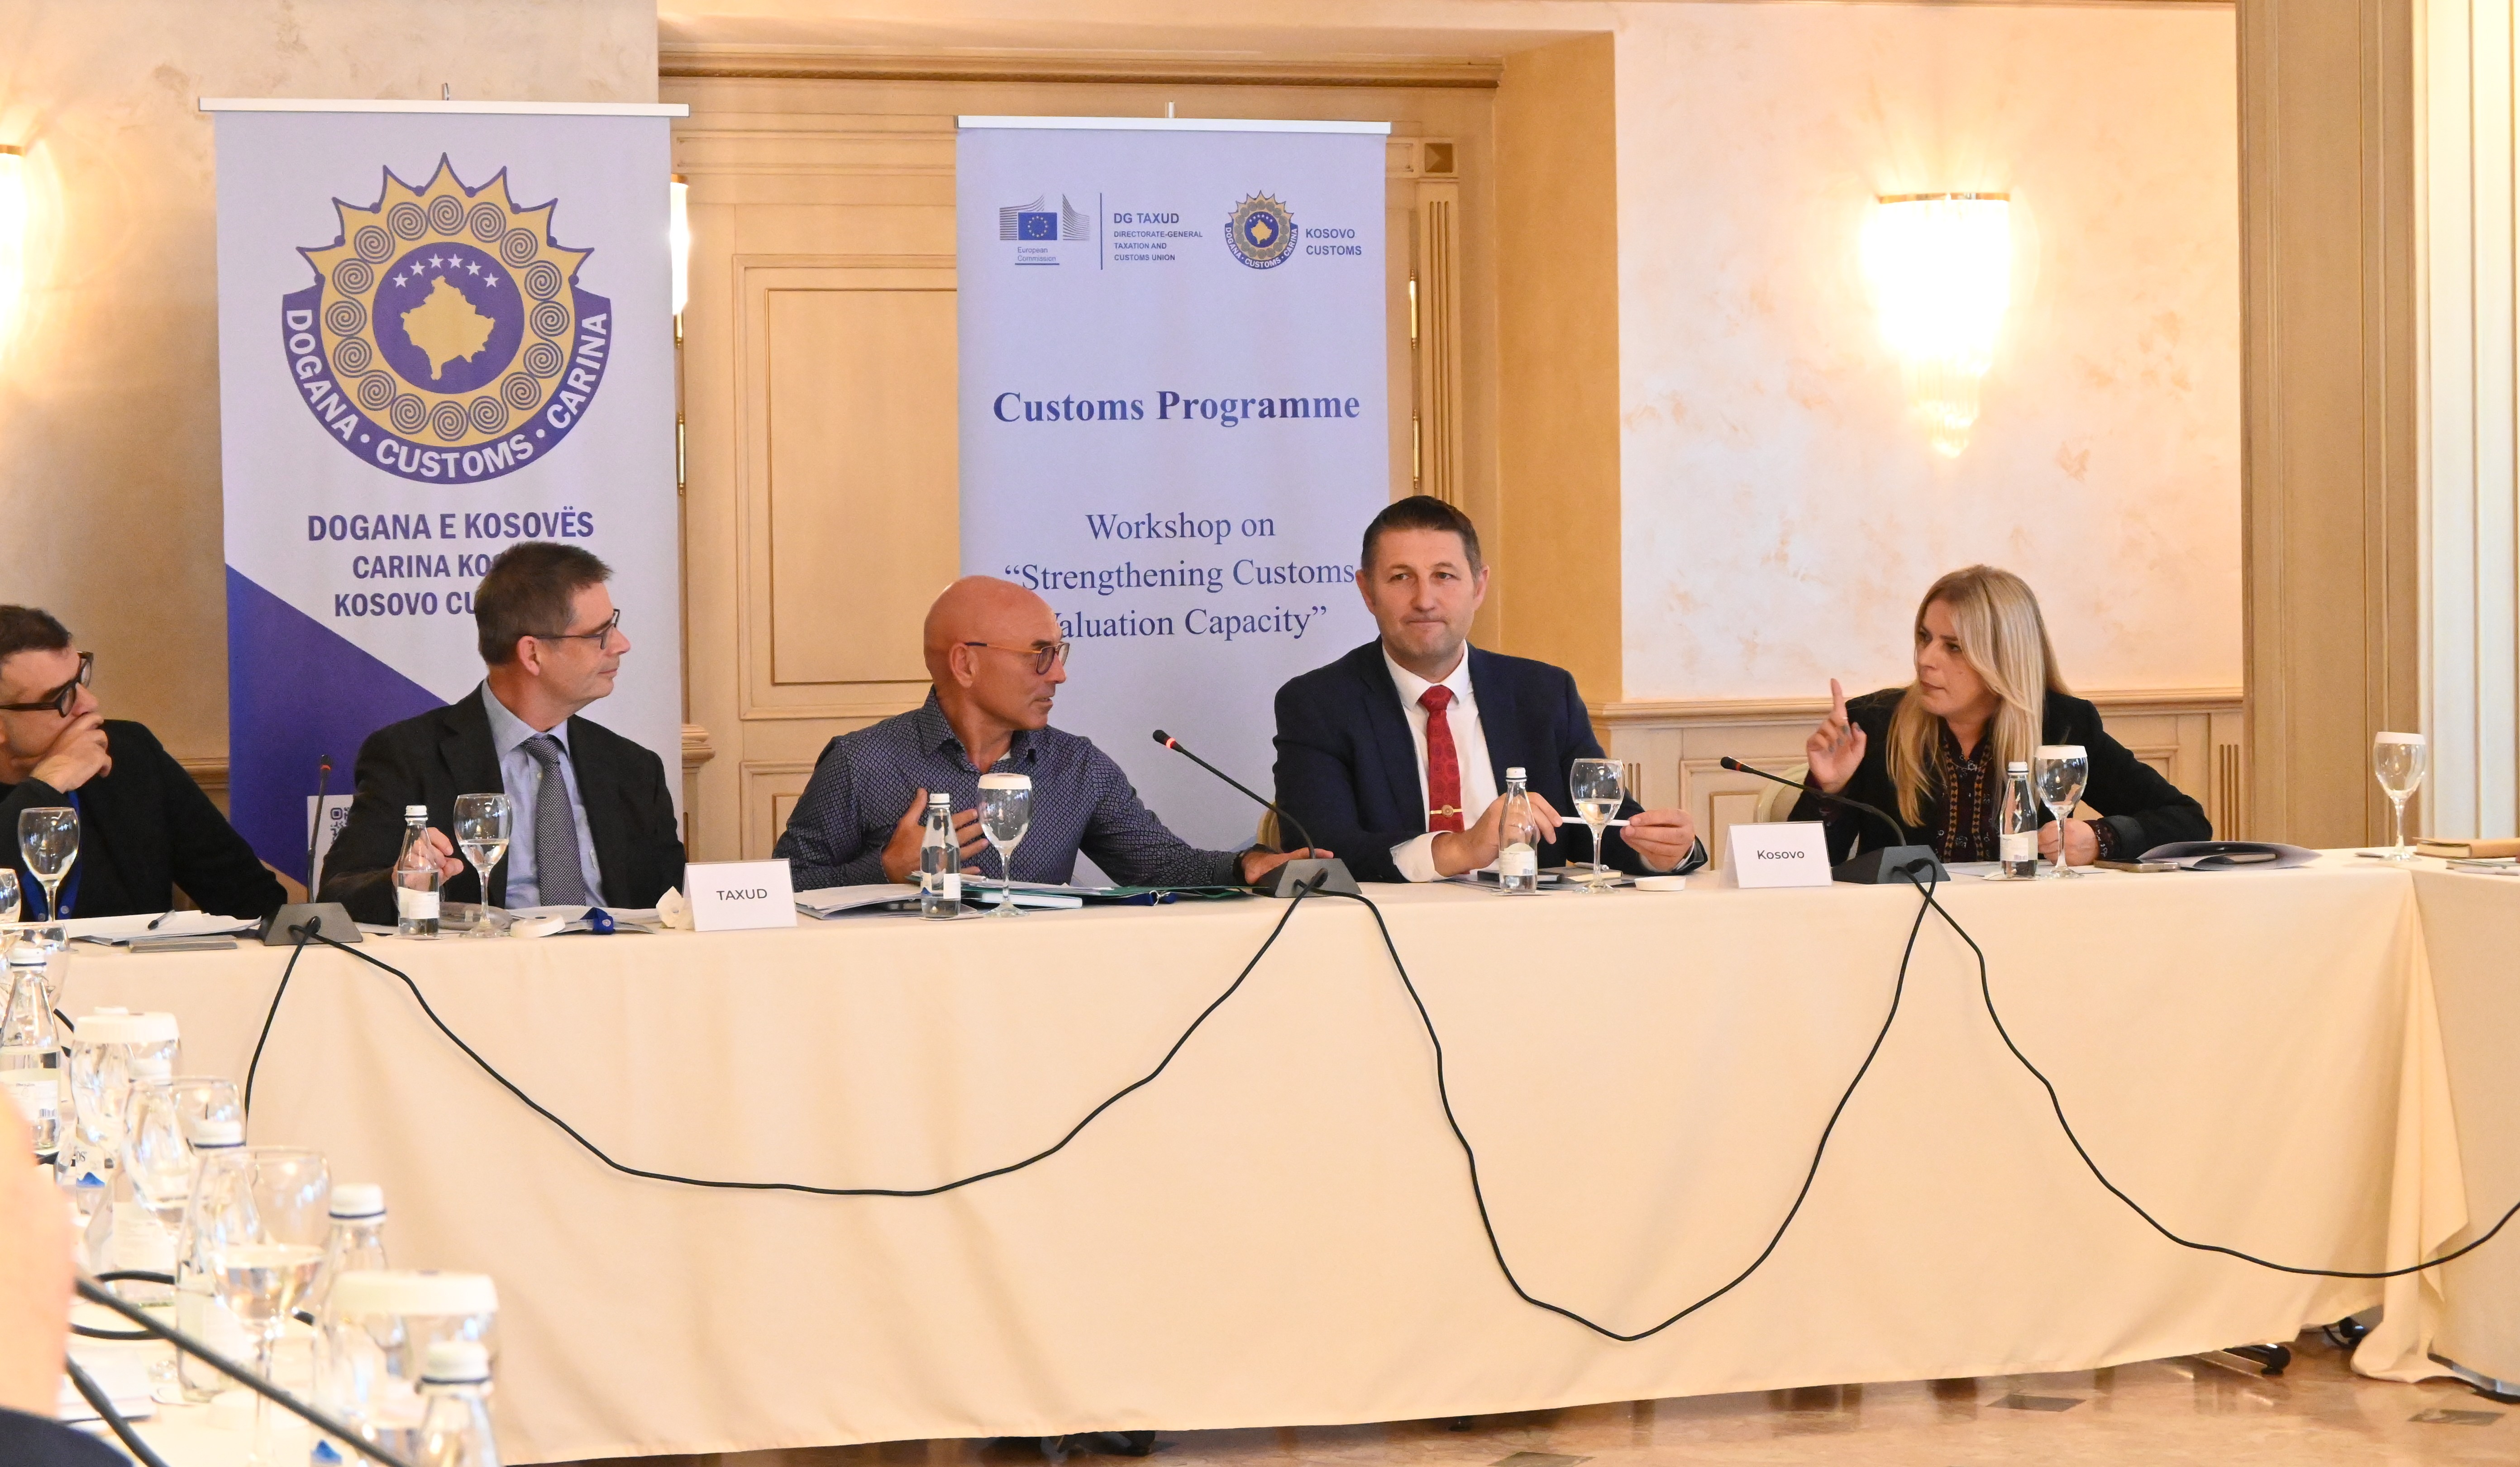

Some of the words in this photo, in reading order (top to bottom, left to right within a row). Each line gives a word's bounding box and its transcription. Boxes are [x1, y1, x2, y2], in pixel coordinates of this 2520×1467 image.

[1114, 213, 1132, 224] DG
[1136, 213, 1179, 224] TAXUD
[1306, 228, 1355, 239] KOSOVO
[1226, 227, 1242, 258] DOGANA
[1245, 257, 1281, 268] CUSTOMS
[1284, 229, 1298, 256] CARINA
[1306, 245, 1362, 256] CUSTOMS
[286, 310, 360, 441] DOGANA
[376, 434, 533, 478] CUSTOMS
[547, 313, 607, 429] CARINA
[993, 392, 1144, 422] Customs
[1156, 391, 1360, 428] Programme
[308, 514, 431, 541] DOGANA
[441, 514, 455, 539] E
[464, 506, 594, 538] KOSOVËS
[1085, 513, 1231, 544] Workshop
[1241, 518, 1275, 537] on
[353, 555, 451, 579] CARINA
[1233, 559, 1355, 585] Customs
[334, 592, 438, 617] KOSOVO
[1185, 605, 1327, 641] Capacity”
[1756, 849, 1805, 860] Kosovo
[716, 888, 768, 901] TAXUD
